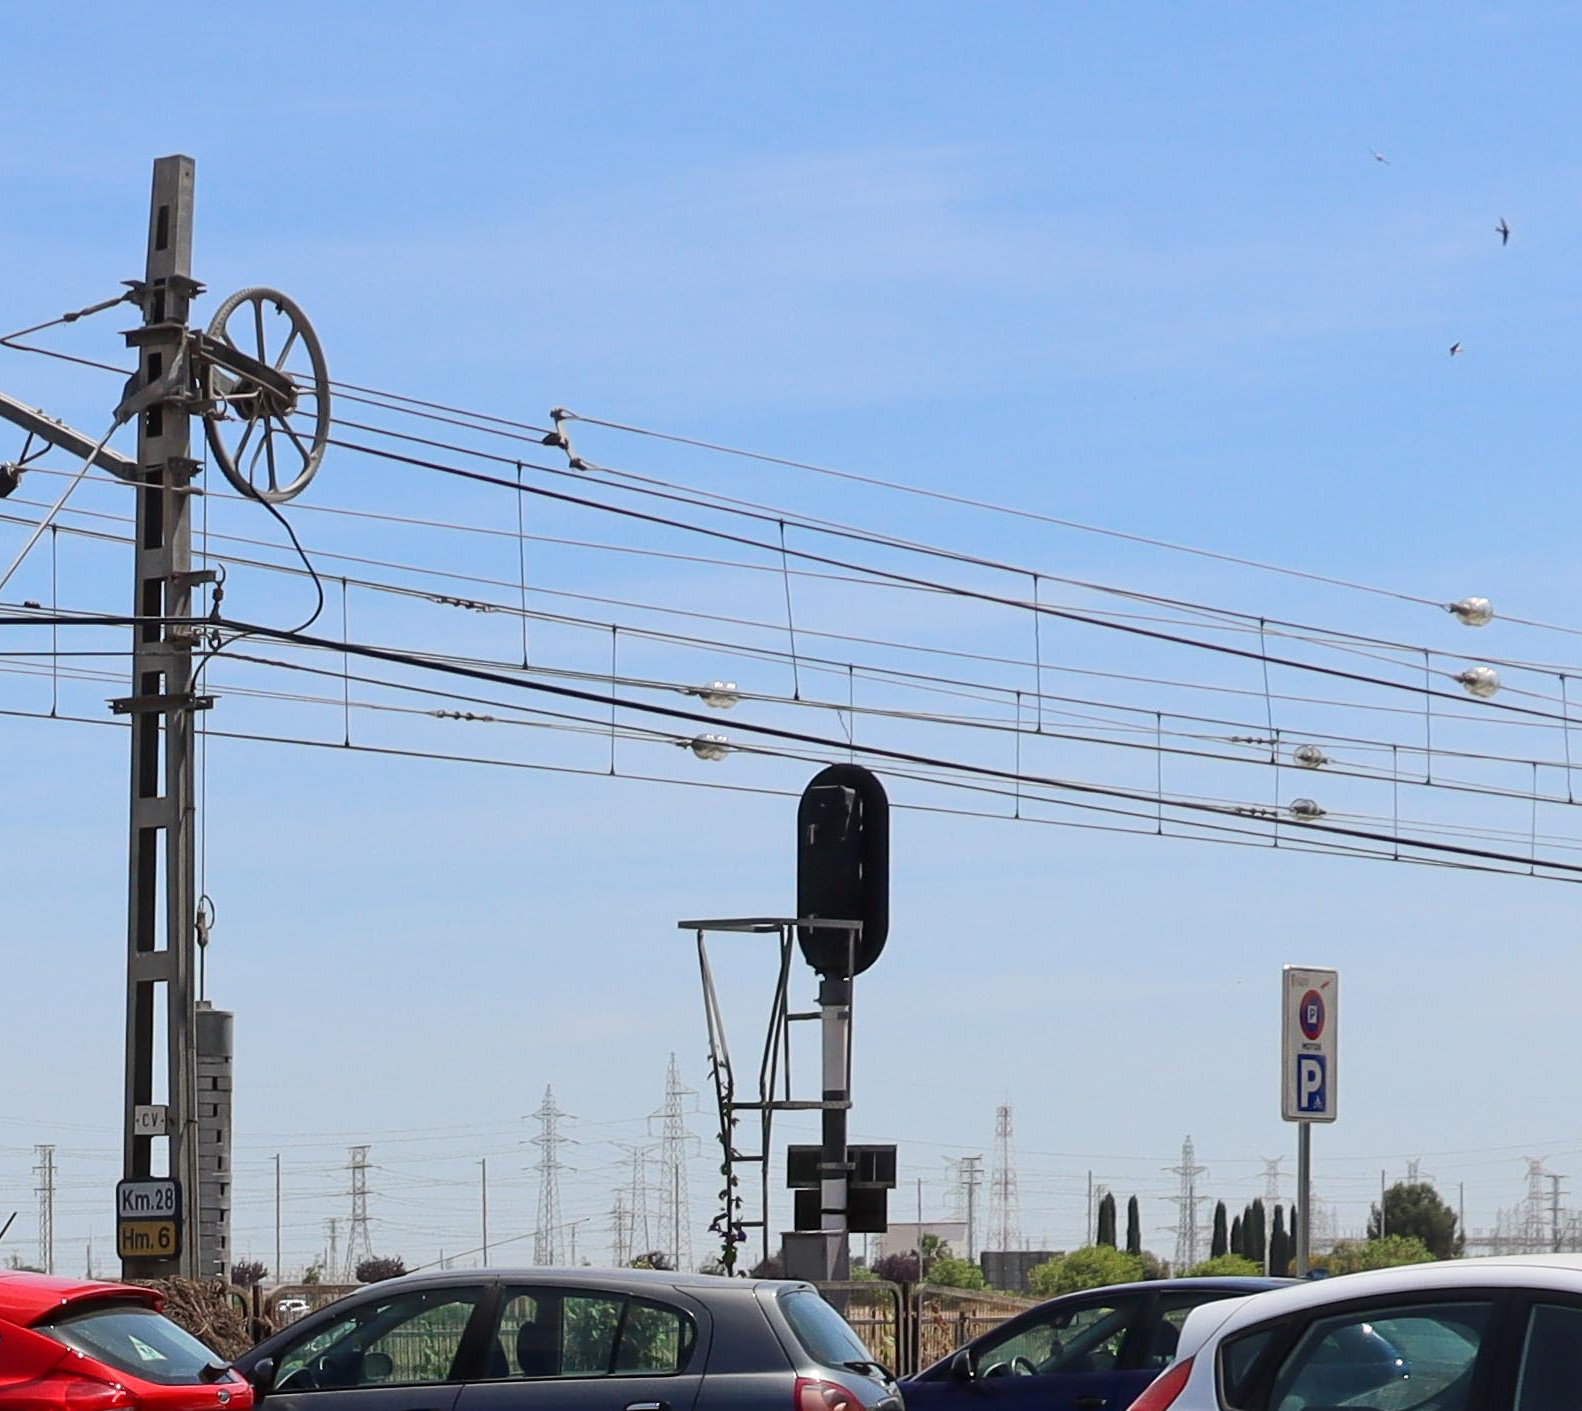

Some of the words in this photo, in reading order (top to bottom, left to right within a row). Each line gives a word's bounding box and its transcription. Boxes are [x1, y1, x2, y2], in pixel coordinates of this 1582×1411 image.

[1301, 1059, 1322, 1108] P
[142, 1112, 158, 1127] CV
[122, 1188, 174, 1211] Km.28
[158, 1226, 171, 1249] 6
